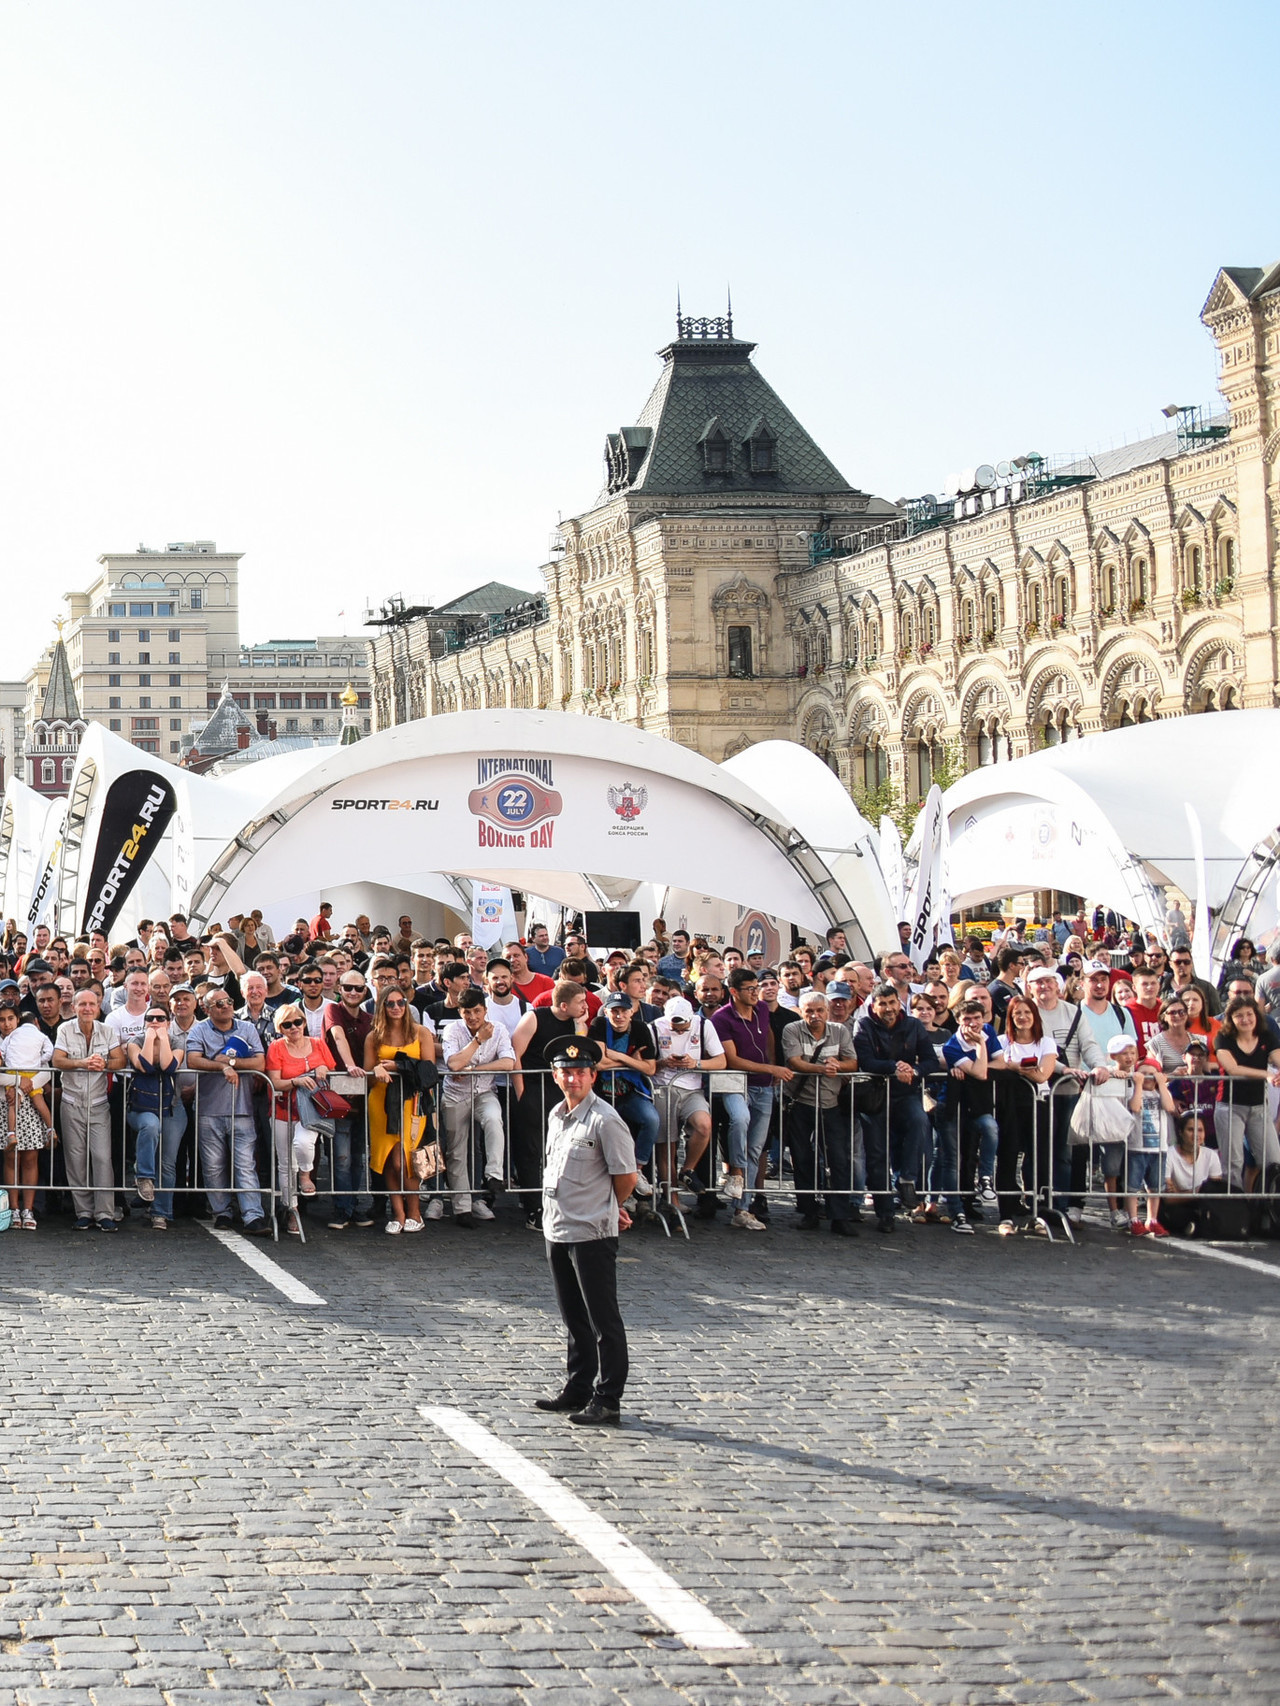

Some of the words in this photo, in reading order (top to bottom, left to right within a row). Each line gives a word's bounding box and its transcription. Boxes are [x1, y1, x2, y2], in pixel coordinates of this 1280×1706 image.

[477, 758, 553, 786] INTERNATIONAL
[331, 800, 439, 811] SPORT24.RU
[503, 790, 527, 808] 22
[505, 808, 524, 816] JULY
[478, 820, 525, 848] BOXING
[530, 820, 554, 848] DAY
[86, 784, 167, 934] SPORT24.RU
[750, 928, 765, 951] 22
